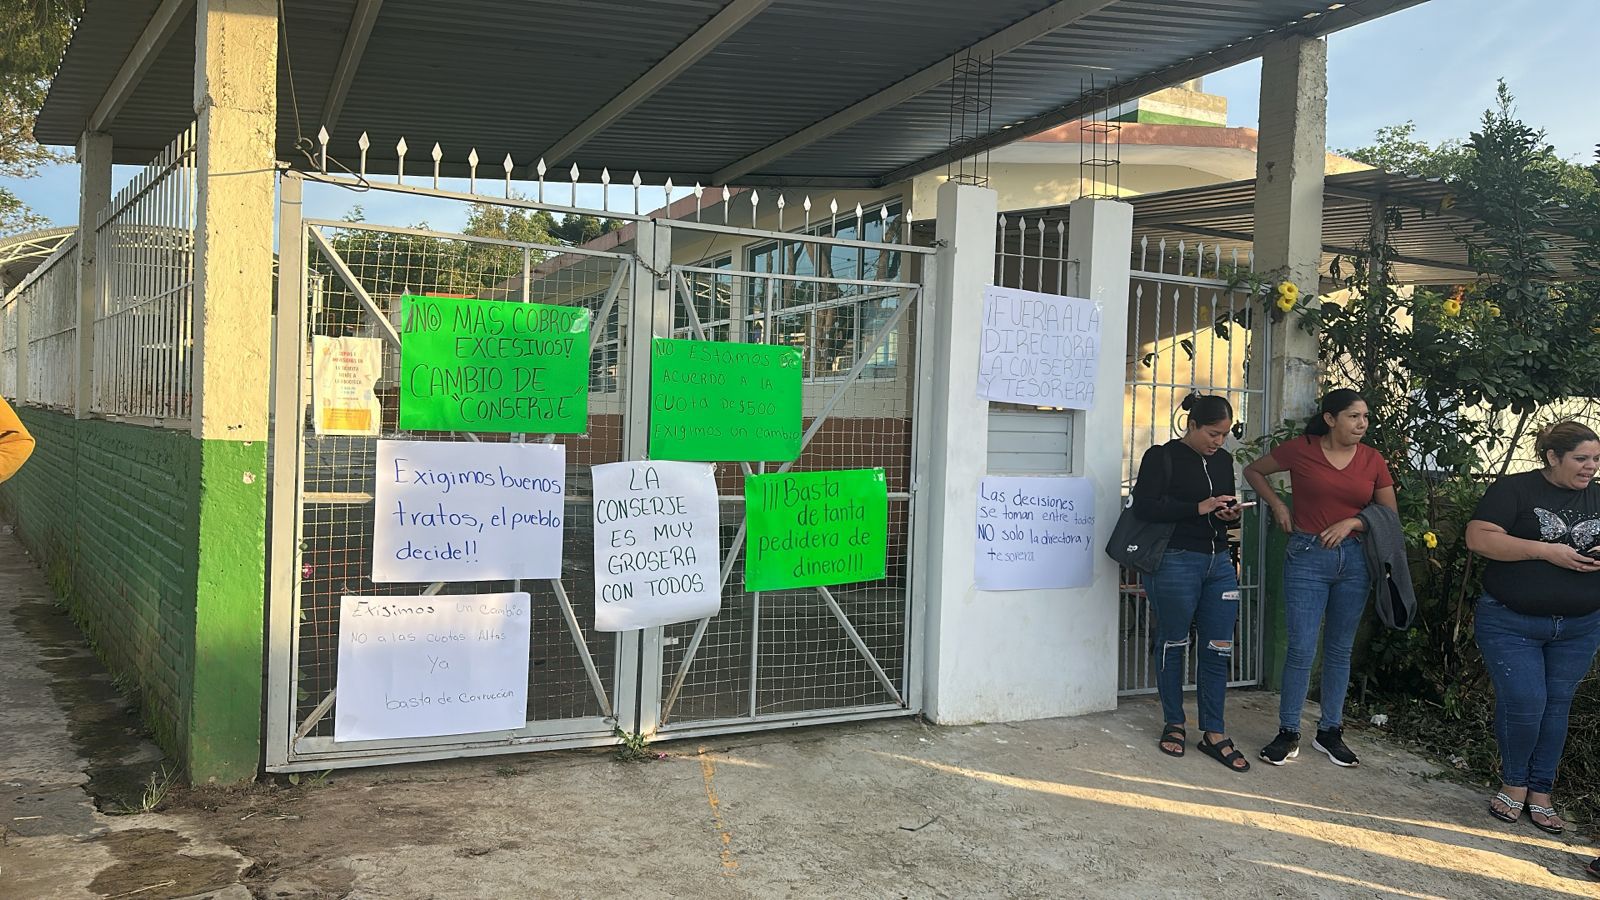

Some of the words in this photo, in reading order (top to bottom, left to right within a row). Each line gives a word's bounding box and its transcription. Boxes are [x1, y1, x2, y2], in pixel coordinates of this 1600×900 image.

[453, 303, 505, 335] MAS
[1077, 306, 1099, 332] LA
[455, 337, 574, 358] EXCESIVOS!
[655, 341, 674, 357] NO
[985, 328, 1095, 358] DIRECTORA
[410, 363, 503, 398] CAMBIO
[512, 366, 546, 393] DE
[980, 355, 1003, 376] LA
[1010, 356, 1095, 379] CONSERJE
[984, 375, 996, 398] Y
[1001, 377, 1095, 403] TESORERA
[739, 399, 776, 416] $500
[394, 458, 495, 493] Exigimos
[498, 466, 561, 494] buenos
[629, 466, 660, 491] LA
[981, 481, 1006, 503] Las
[1013, 488, 1074, 511] decisiones
[392, 501, 484, 533] tratos,
[491, 506, 506, 527] el
[511, 509, 561, 530] pueblo
[596, 496, 687, 524] CONSERJE
[797, 504, 819, 526] de
[823, 498, 865, 523] tanta
[1002, 504, 1034, 520] toman
[1042, 509, 1069, 522] entre
[1074, 512, 1095, 526] todos
[611, 529, 636, 548] ES
[653, 521, 693, 541] MUY
[758, 529, 839, 560] pedidera
[848, 526, 871, 547] de
[978, 523, 995, 542] NO
[1001, 524, 1025, 541] solo
[1030, 528, 1039, 544] la
[1041, 530, 1082, 545] directora
[1085, 535, 1091, 551] y
[396, 540, 478, 563] decide!!
[608, 545, 697, 575] GROSERA
[602, 581, 633, 603] CON
[351, 632, 368, 644] NO
[377, 635, 387, 643] a
[392, 631, 416, 642] las
[426, 629, 466, 643] cuotas
[427, 655, 449, 674] Ya
[385, 691, 431, 710] basta
[438, 691, 453, 705] de
